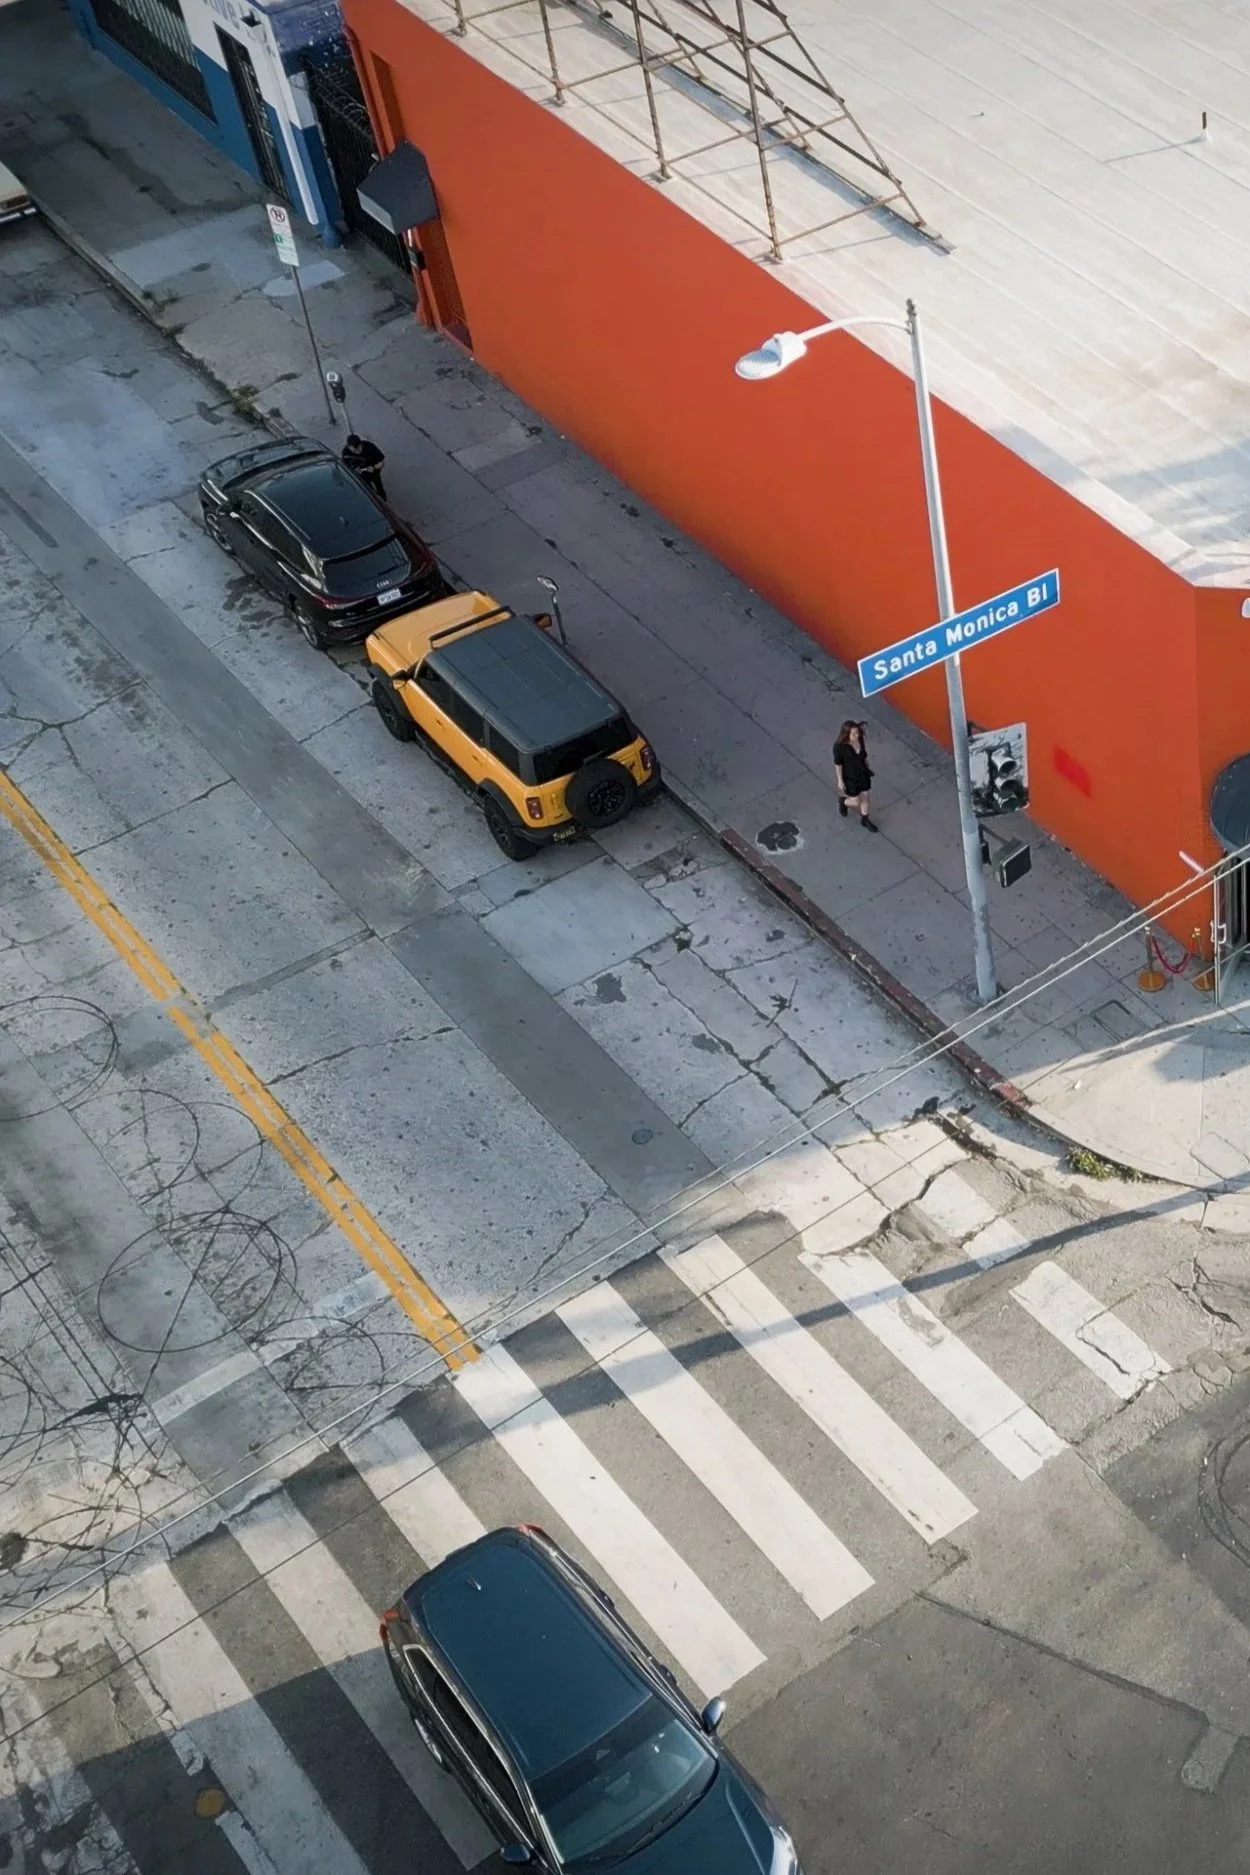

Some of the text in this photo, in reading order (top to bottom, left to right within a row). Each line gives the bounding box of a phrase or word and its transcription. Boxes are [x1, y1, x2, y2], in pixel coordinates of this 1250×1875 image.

[873, 582, 1048, 681] Santa Monica Bl
